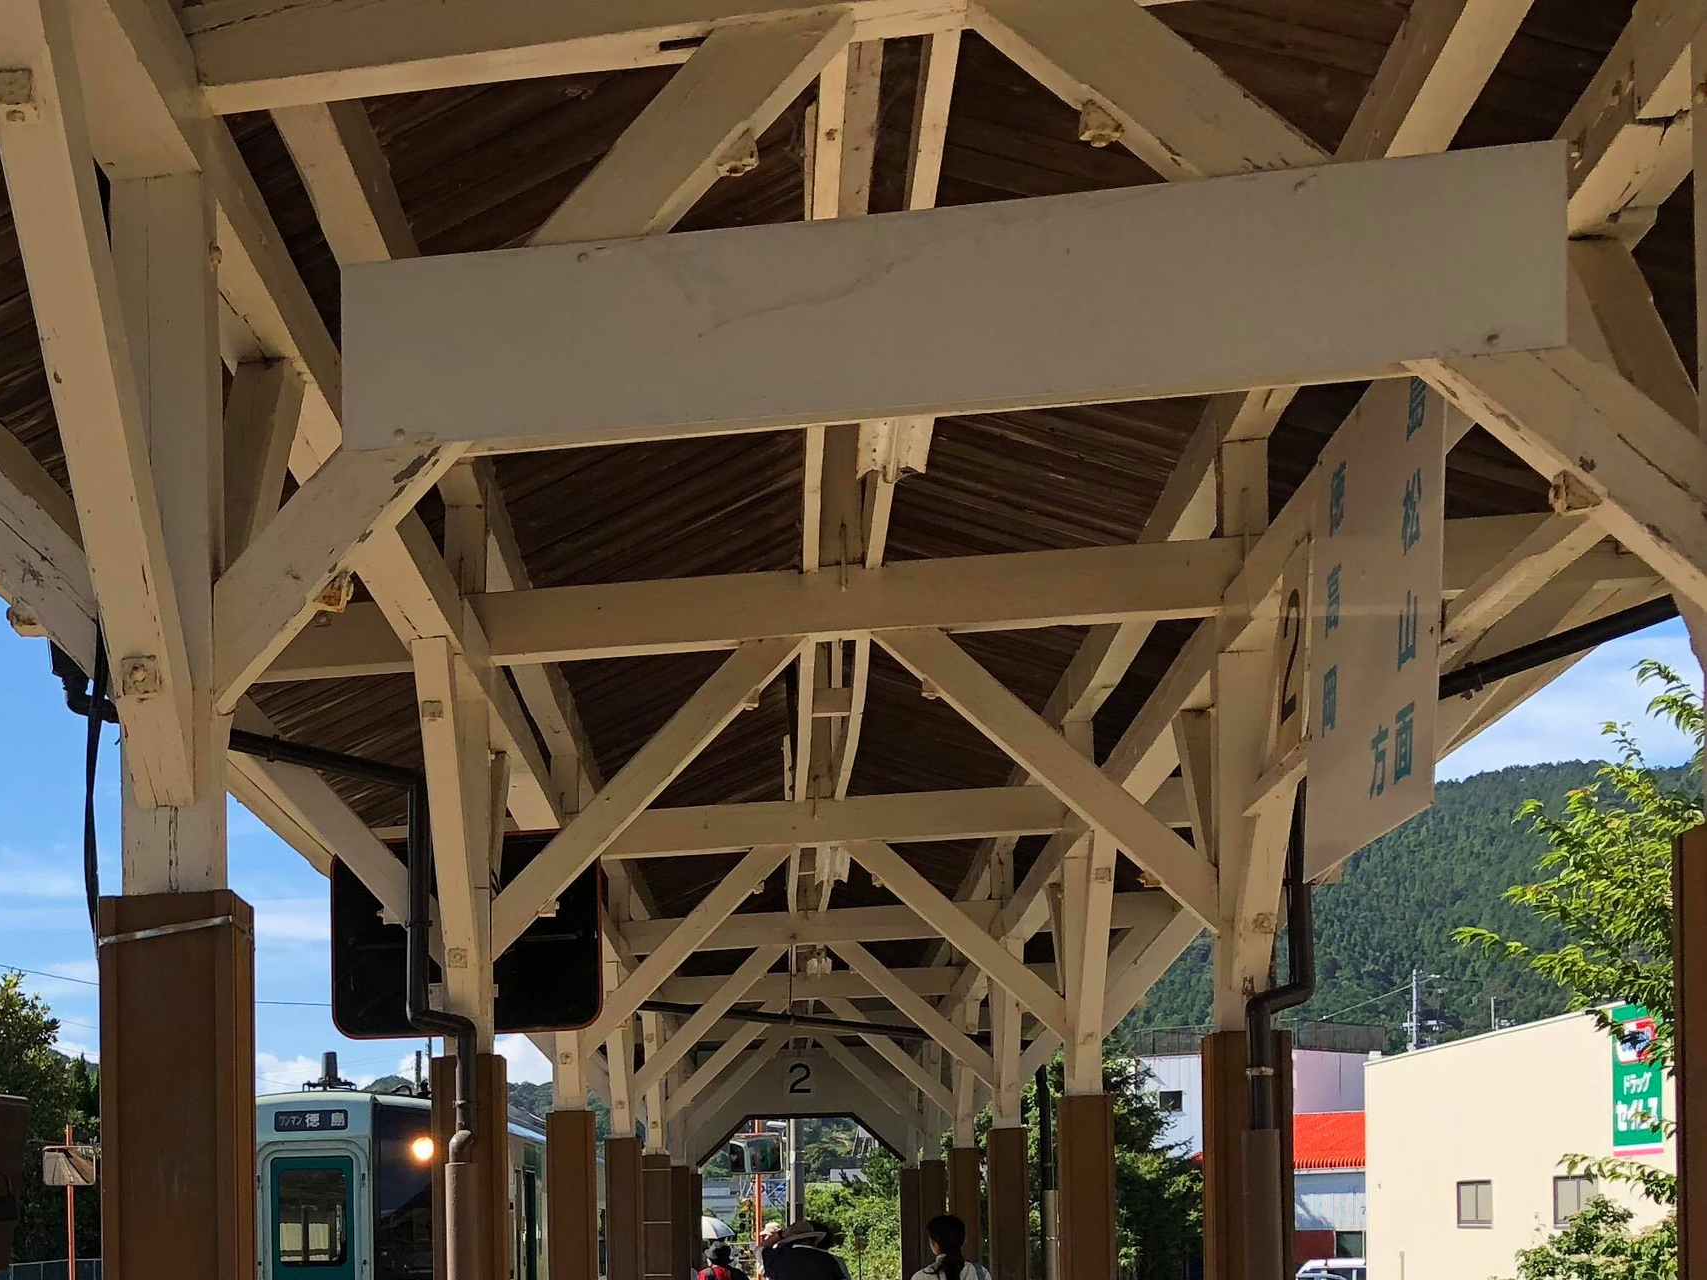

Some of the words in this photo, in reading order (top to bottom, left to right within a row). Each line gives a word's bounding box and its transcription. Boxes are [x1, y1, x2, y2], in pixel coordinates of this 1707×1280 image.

[1280, 588, 1301, 726] 2
[788, 1062, 812, 1094] 2
[1623, 1071, 1652, 1096] ドラッグ
[279, 1115, 302, 1126] ワンマン
[305, 1112, 345, 1128] 徳島
